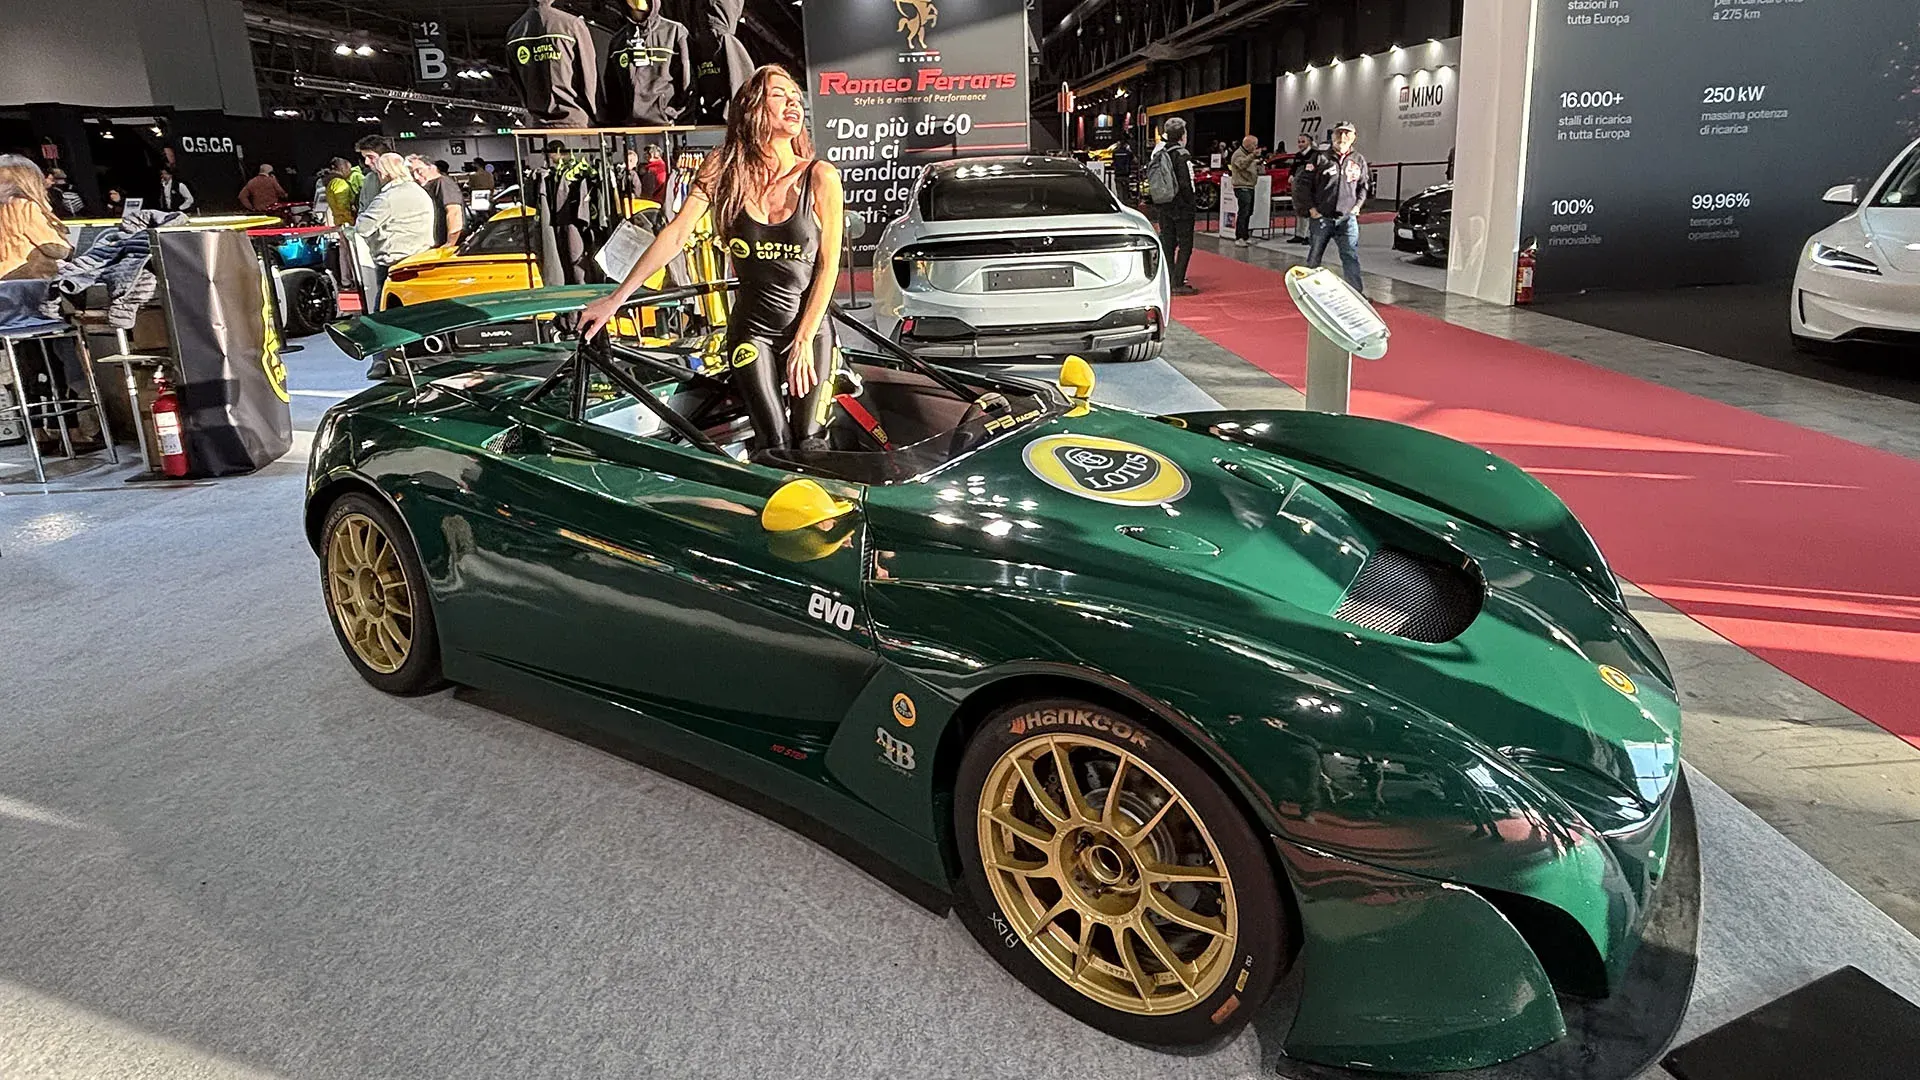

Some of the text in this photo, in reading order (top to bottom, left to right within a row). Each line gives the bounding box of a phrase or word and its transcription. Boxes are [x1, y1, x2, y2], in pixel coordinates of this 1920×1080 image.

[1568, 0, 1619, 9] stazioni in
[1567, 13, 1630, 26] tutta Europa
[1712, 9, 1760, 20] a 275 km
[420, 22, 440, 36] 12
[419, 47, 447, 79] B
[819, 68, 1016, 95] Romeo Ferraris
[854, 97, 875, 107] Style
[877, 96, 884, 105] is
[894, 96, 922, 104] matter
[923, 94, 933, 103] of
[934, 93, 987, 103] Performance
[1411, 85, 1444, 108] MIMO
[1560, 91, 1624, 108] 16.000+
[1703, 85, 1766, 103] 250 kW
[1558, 113, 1632, 126] stalli di ricarica
[1701, 109, 1788, 121] massima potenza
[875, 116, 908, 143] più
[915, 116, 936, 136] di
[942, 113, 971, 135] 60
[1301, 116, 1322, 133] 777
[1700, 123, 1748, 135] di ricarica
[1557, 128, 1631, 141] in tutta Europa
[451, 146, 463, 154] 12
[827, 139, 900, 161] anni ci
[843, 187, 877, 204] ura
[1691, 192, 1750, 211] 99,96%
[1551, 198, 1594, 215] 100%
[1550, 221, 1587, 234] energia
[755, 241, 802, 254] LOTUS
[757, 250, 782, 260] CUP
[784, 252, 814, 260] ITALY
[1084, 453, 1149, 489] LOTUS
[808, 592, 856, 631] evo
